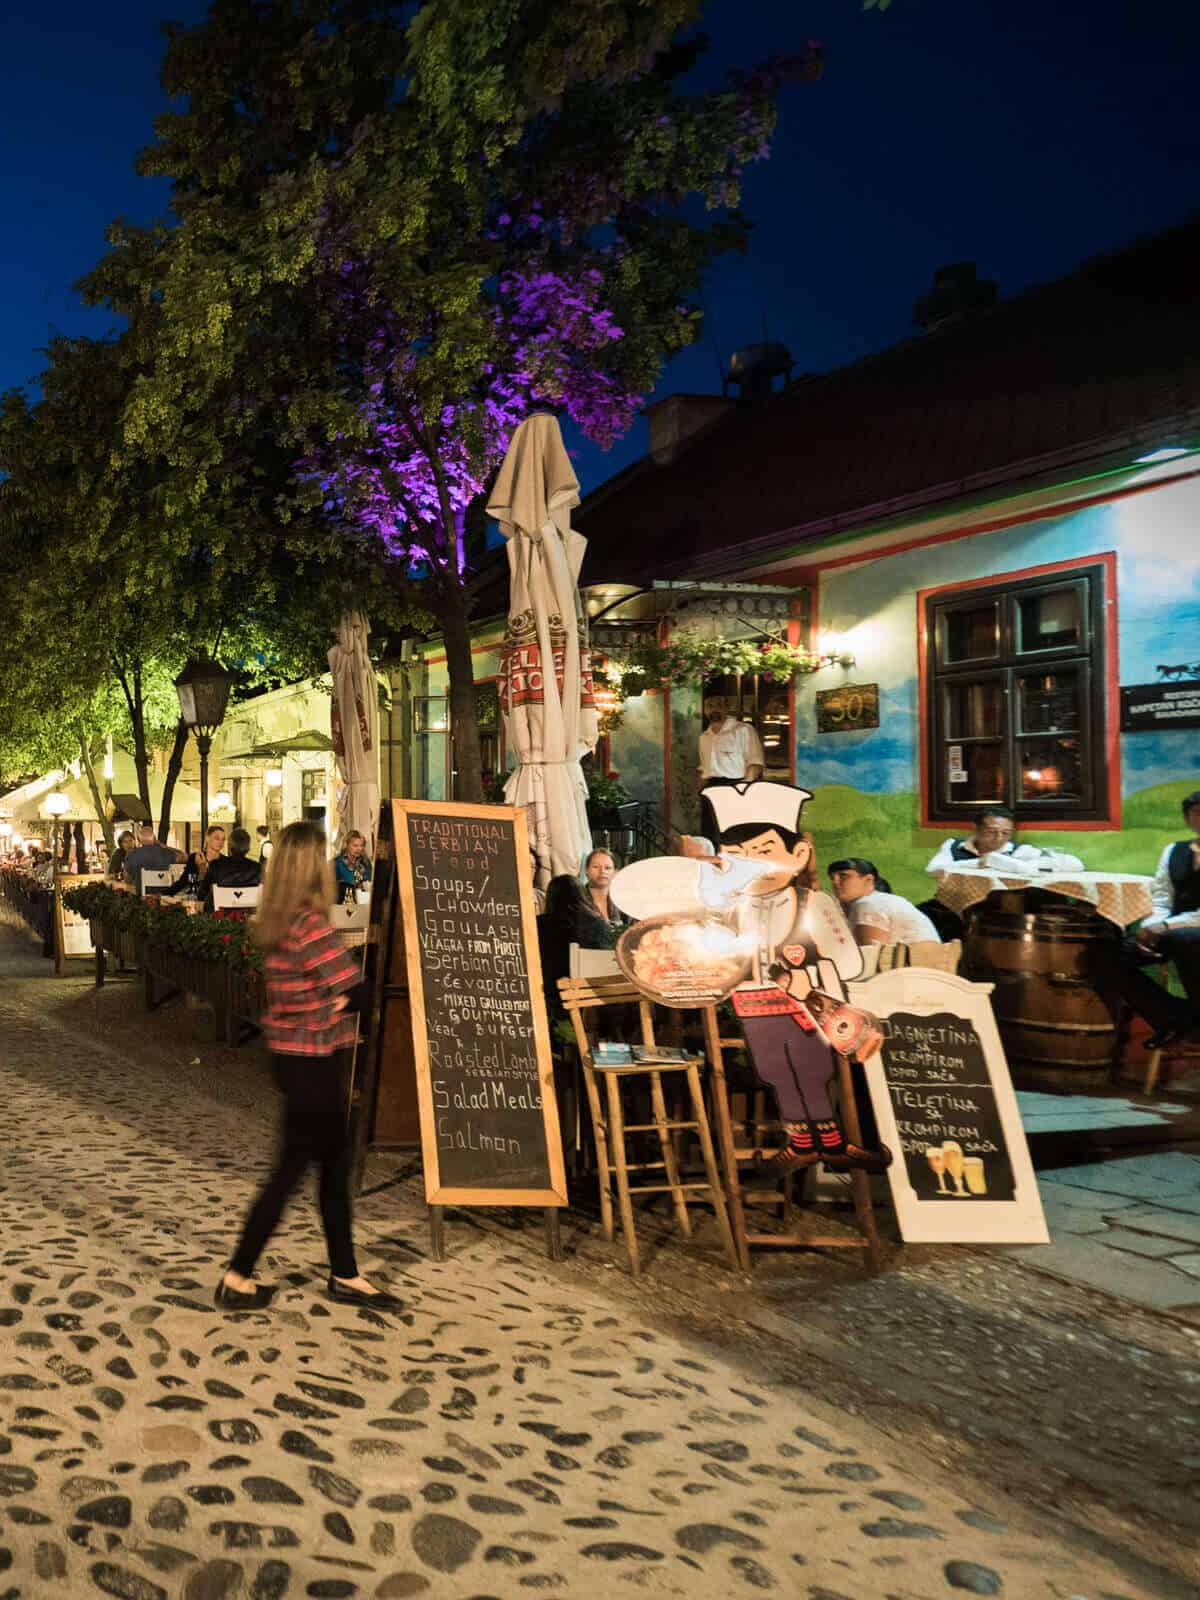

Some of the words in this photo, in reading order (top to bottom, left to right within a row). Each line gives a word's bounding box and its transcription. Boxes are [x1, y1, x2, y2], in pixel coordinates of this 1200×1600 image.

[410, 819, 512, 840] TRADITIONAL
[416, 834, 498, 856] SERBIAN
[425, 949, 491, 972] Serbian
